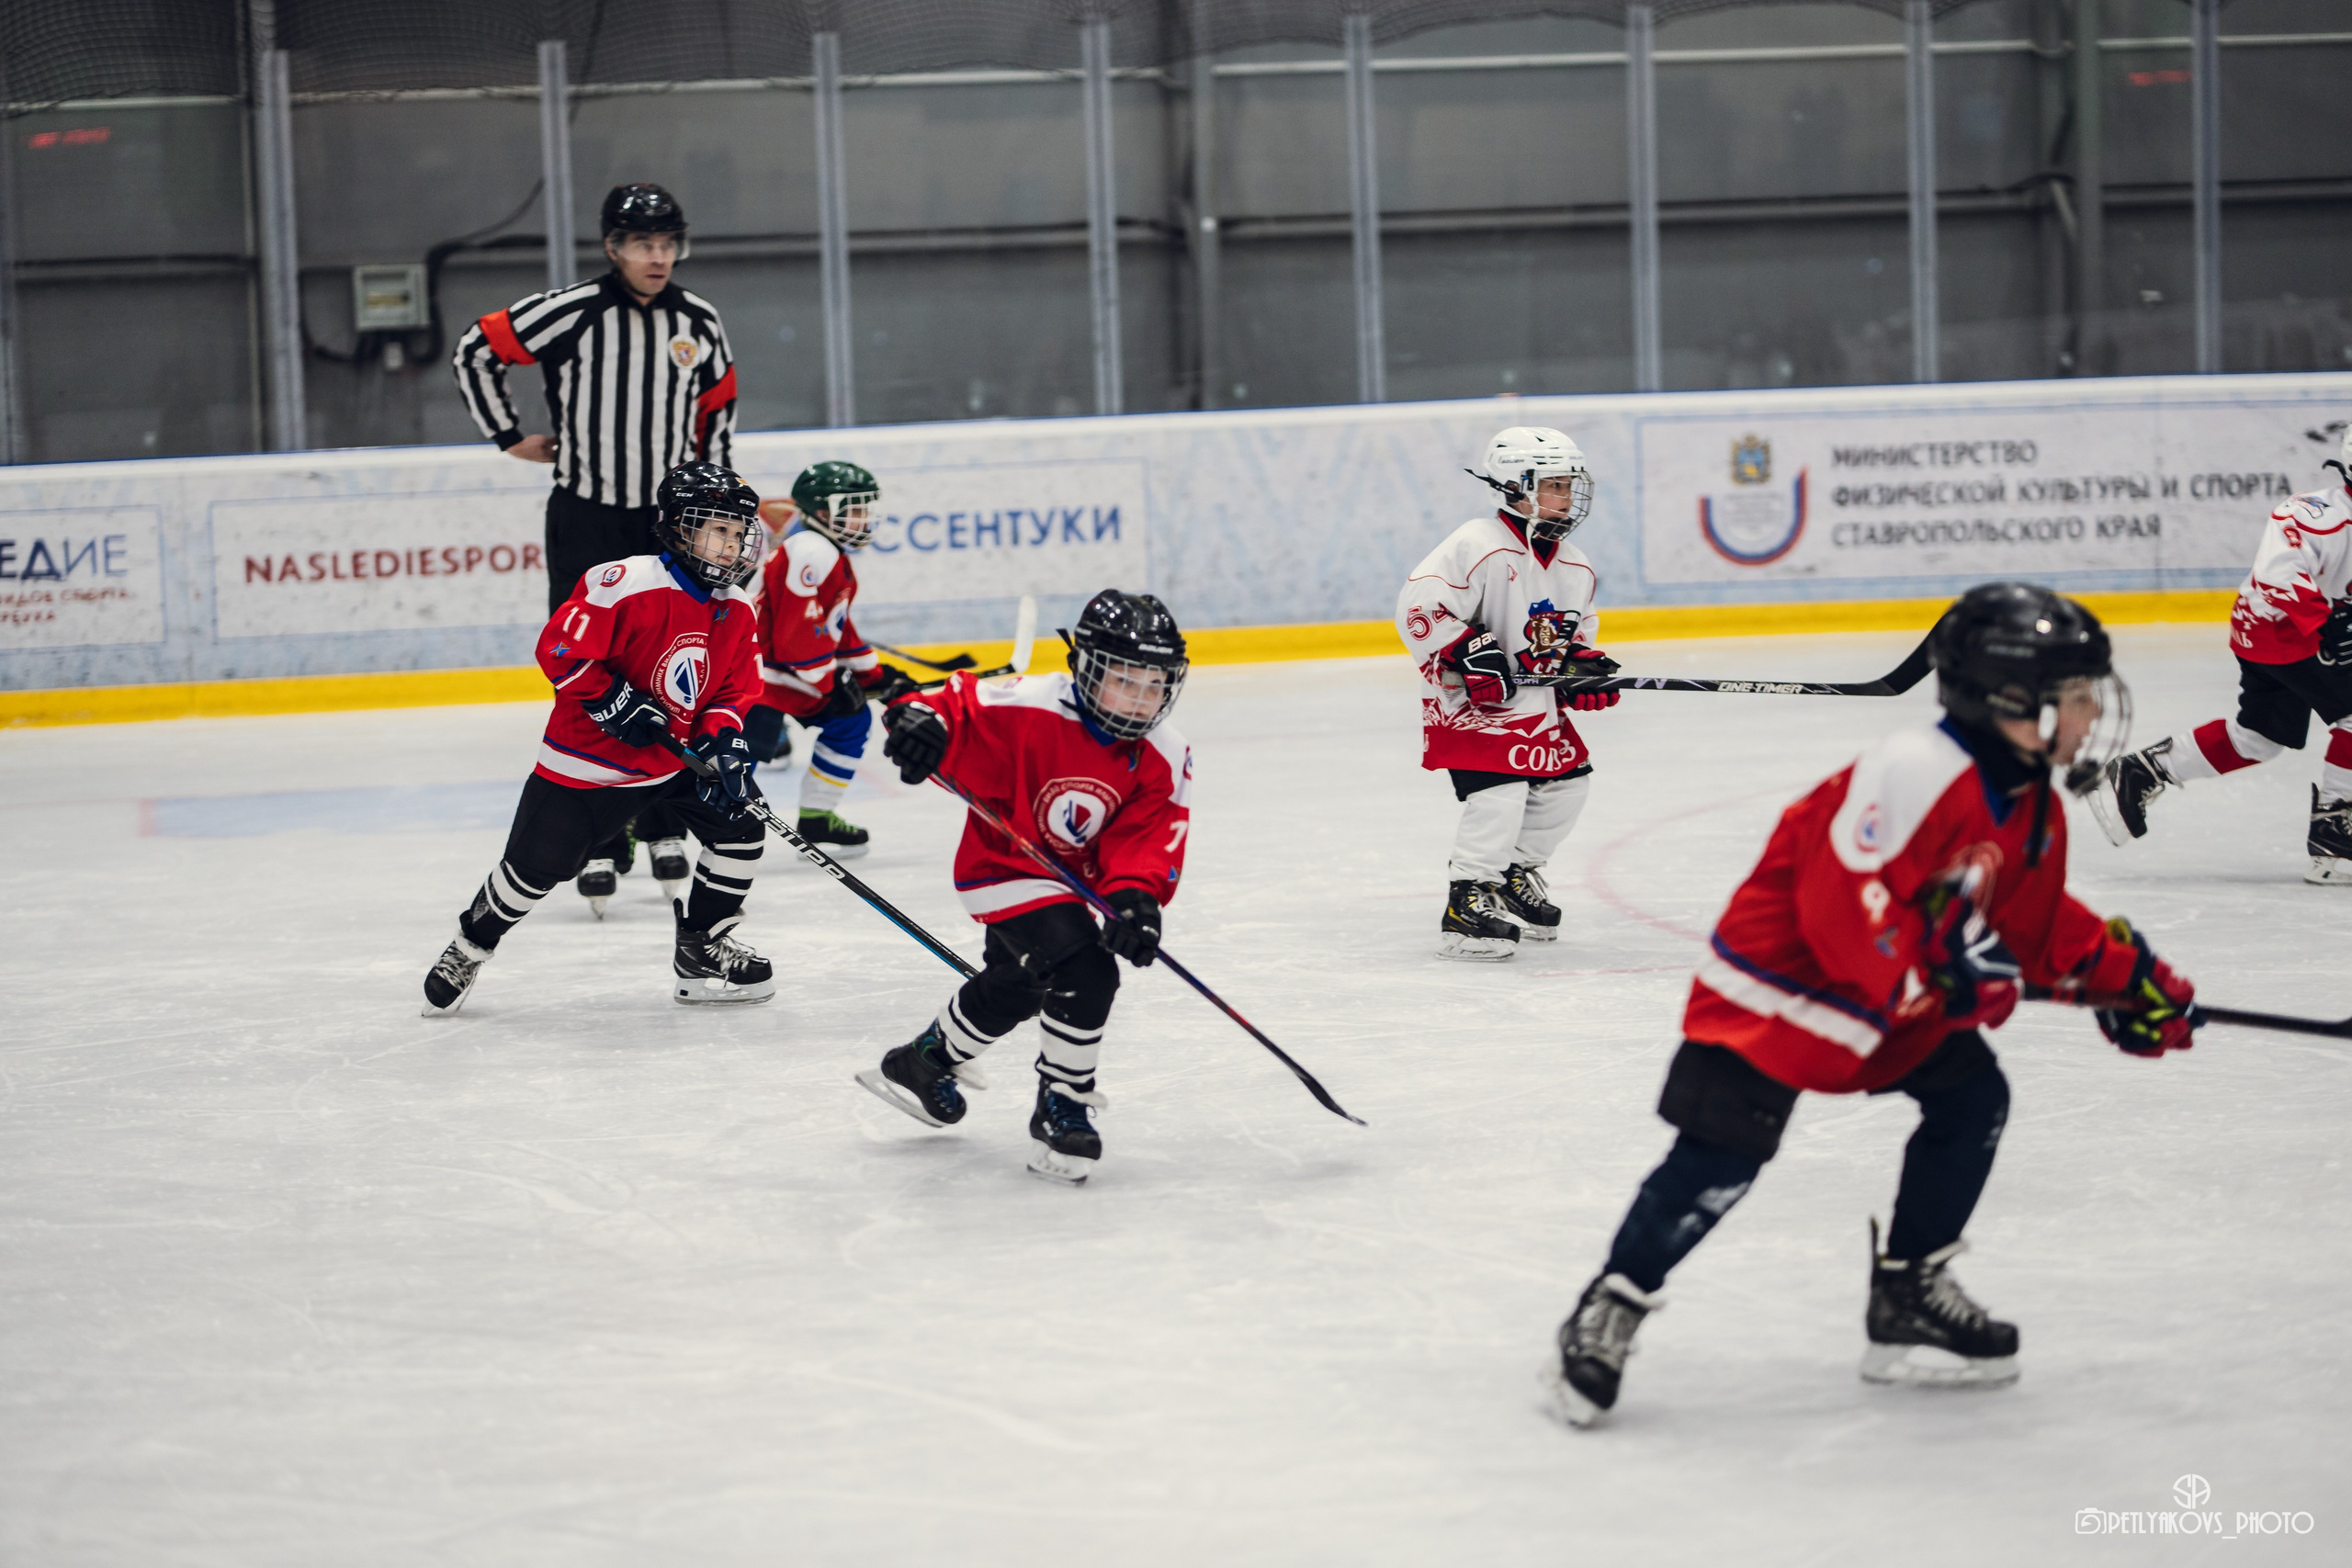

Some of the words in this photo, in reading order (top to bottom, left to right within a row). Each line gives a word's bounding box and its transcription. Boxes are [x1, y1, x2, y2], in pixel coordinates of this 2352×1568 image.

[1832, 439, 2037, 467] МИНИСТЕРСТВО
[1832, 474, 2005, 506] ФИЗИЧЕСКОЙ
[2018, 476, 2151, 502] КУЛЬТУРЫ
[2161, 476, 2179, 499] И
[2189, 472, 2293, 501] СПОРТА
[843, 503, 1121, 554] ССЕНТУКИ
[1832, 516, 2084, 547] СТАВРОПОЛЬСКОГО
[2097, 513, 2161, 540] КРАЯ
[0, 590, 53, 607] ИДОВ
[562, 606, 591, 642] 11
[676, 637, 704, 648] СПОРТА
[1861, 880, 1891, 925] 9
